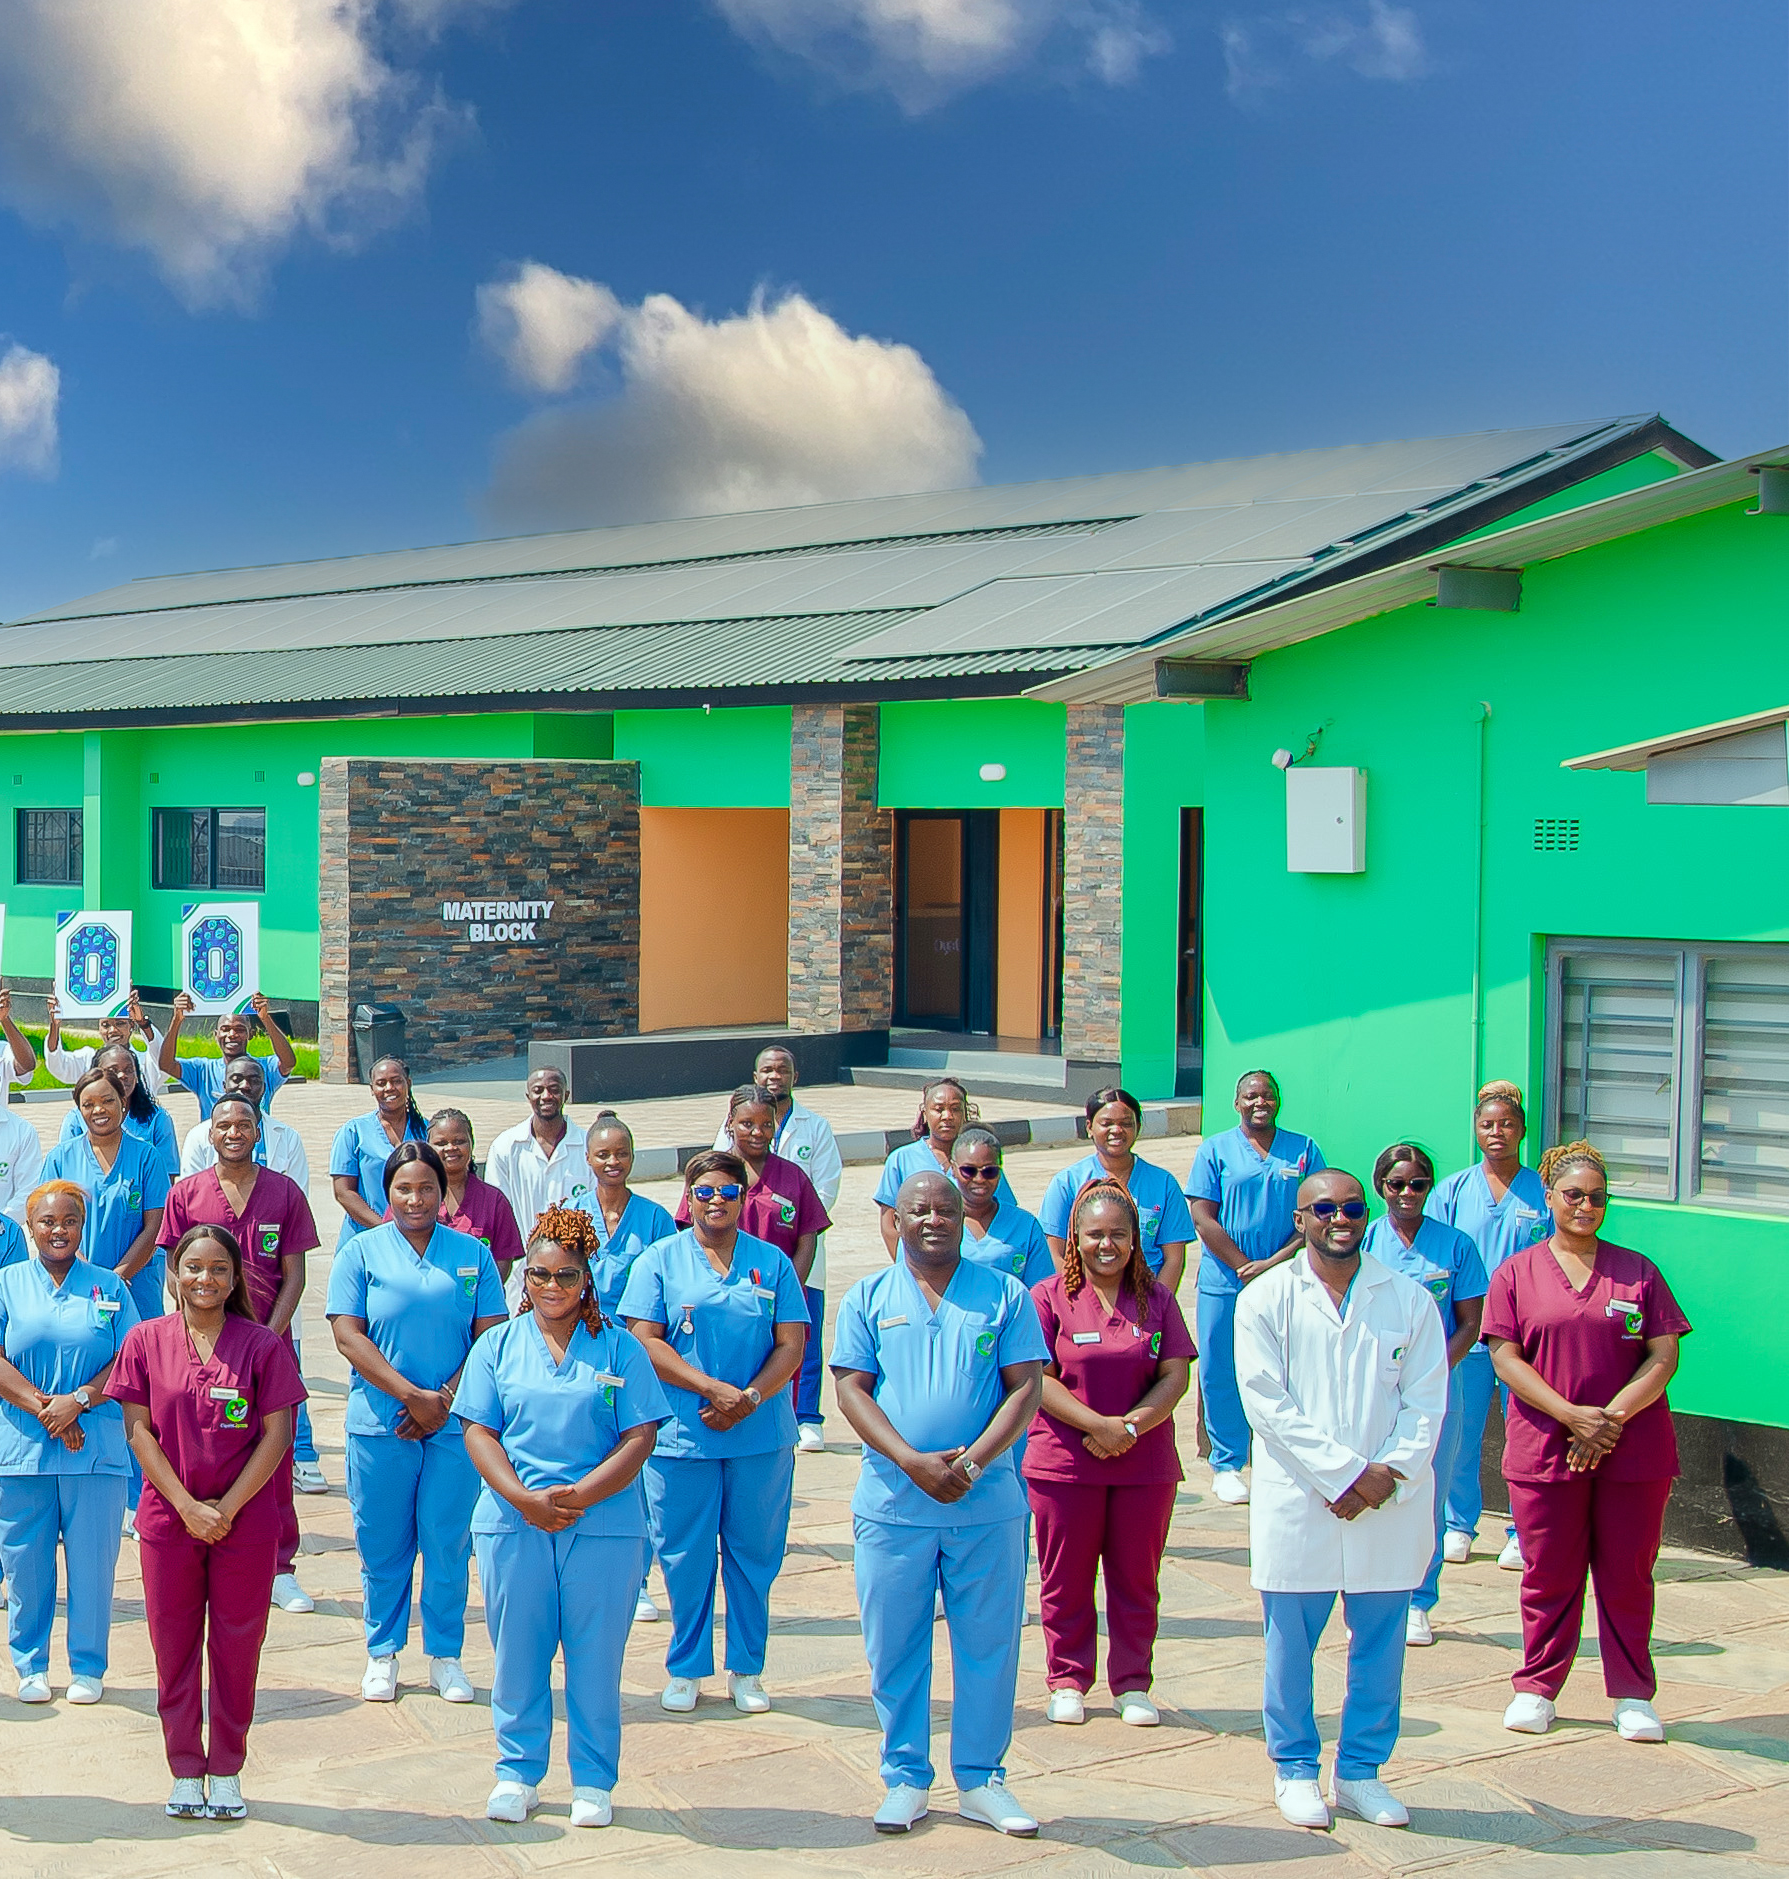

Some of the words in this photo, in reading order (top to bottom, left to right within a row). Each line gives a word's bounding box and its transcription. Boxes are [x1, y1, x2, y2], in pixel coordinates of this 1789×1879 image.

[443, 901, 554, 920] MATERNITY
[469, 922, 536, 942] BLOCK
[65, 923, 120, 1005] 0
[188, 915, 243, 1003] 0
